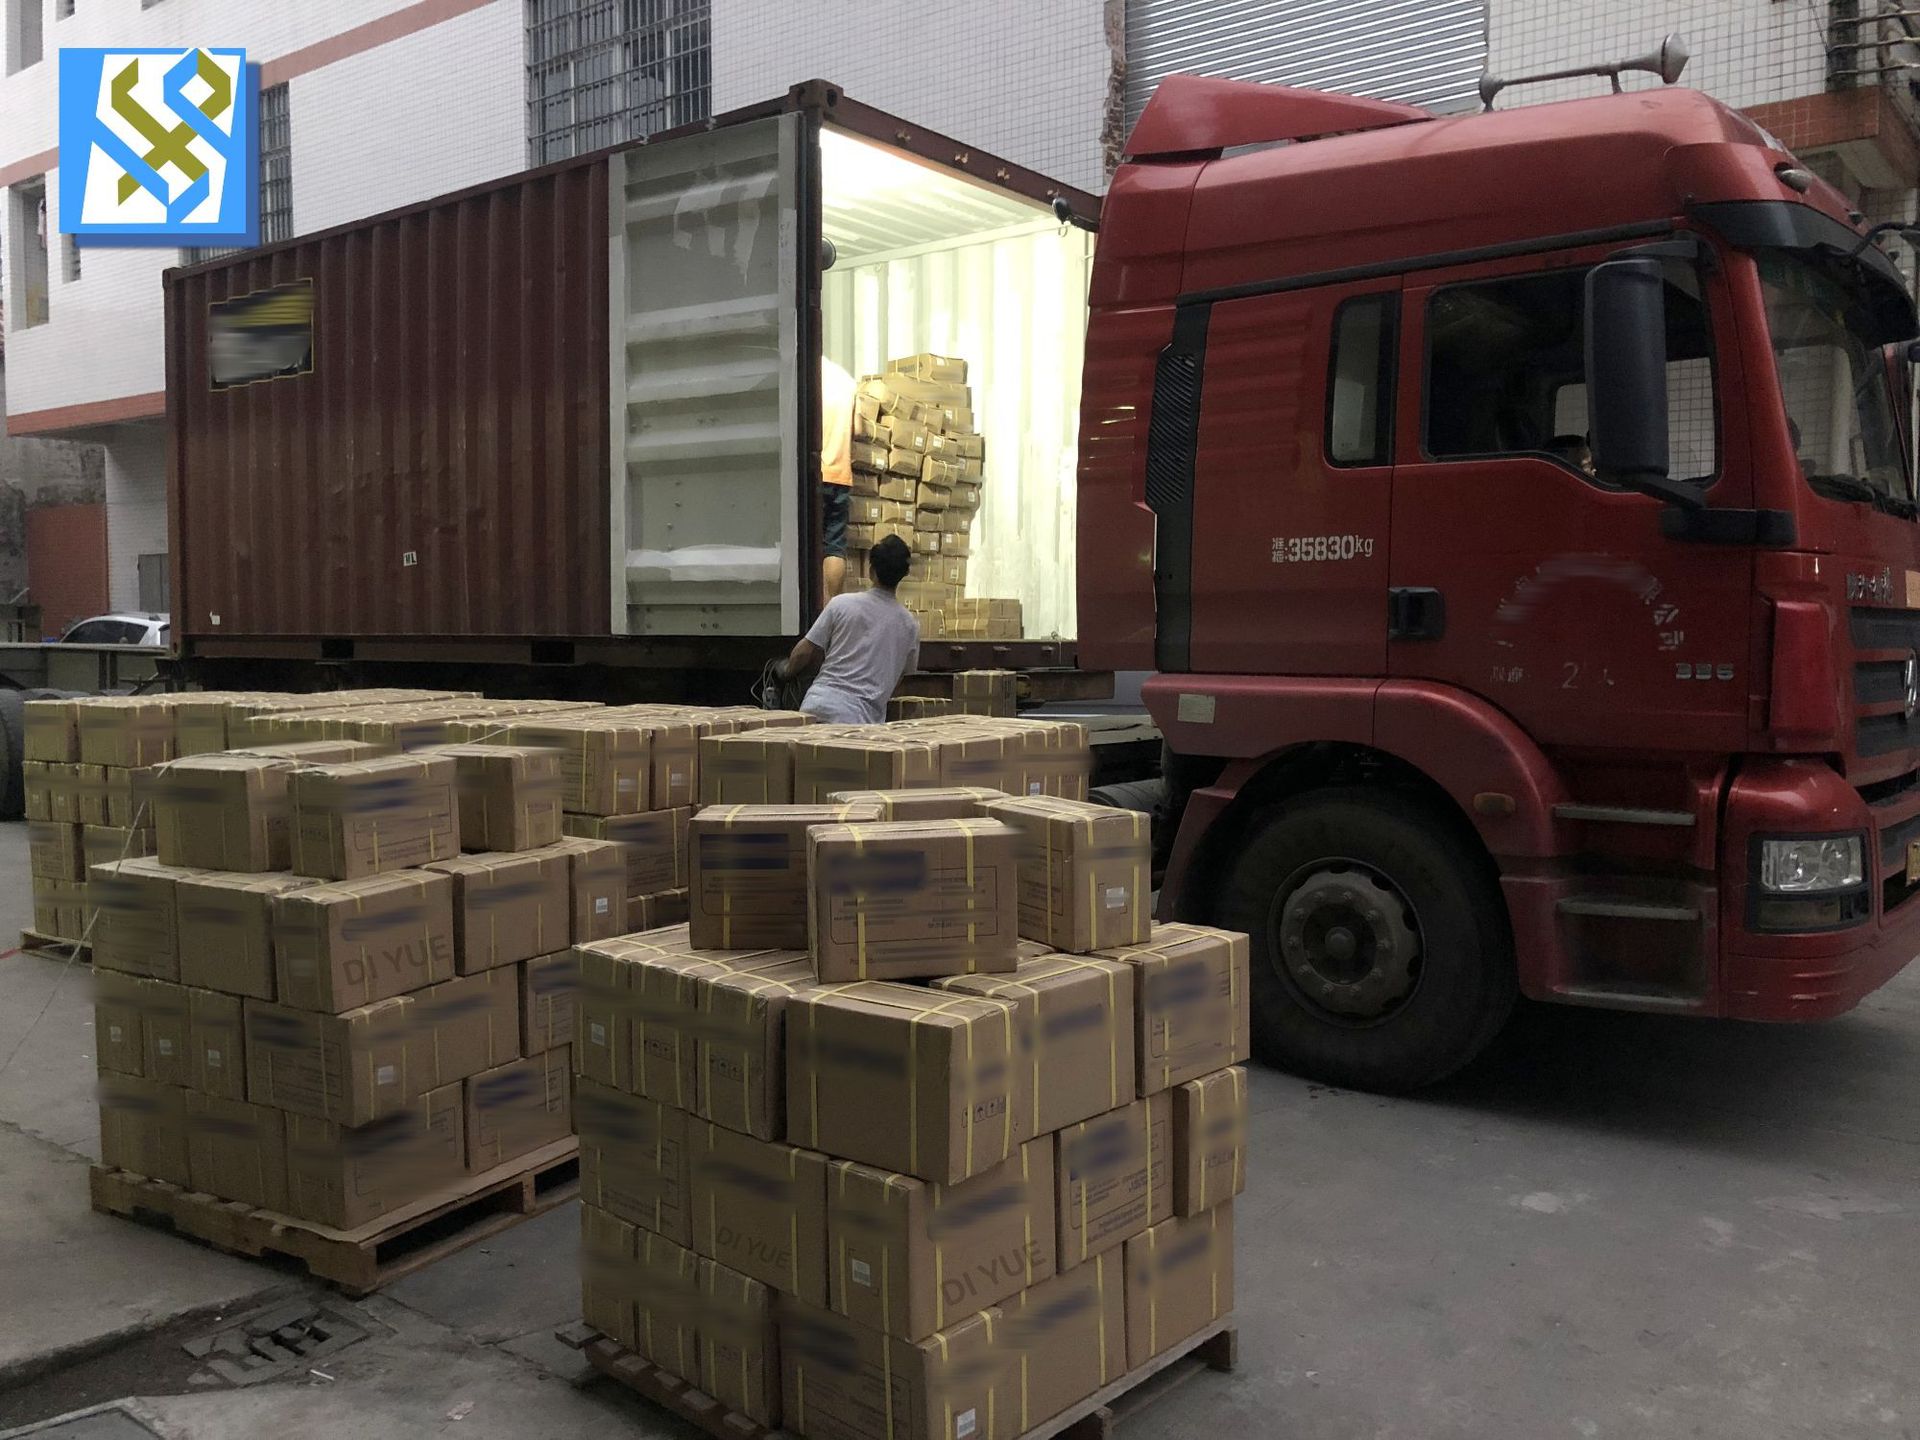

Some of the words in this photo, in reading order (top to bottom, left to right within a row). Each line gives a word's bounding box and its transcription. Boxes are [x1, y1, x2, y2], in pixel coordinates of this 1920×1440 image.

[1288, 534, 1374, 562] 35830kg
[382, 934, 450, 973] YUE
[941, 1271, 978, 1306] DI
[976, 1239, 1047, 1285] YUE
